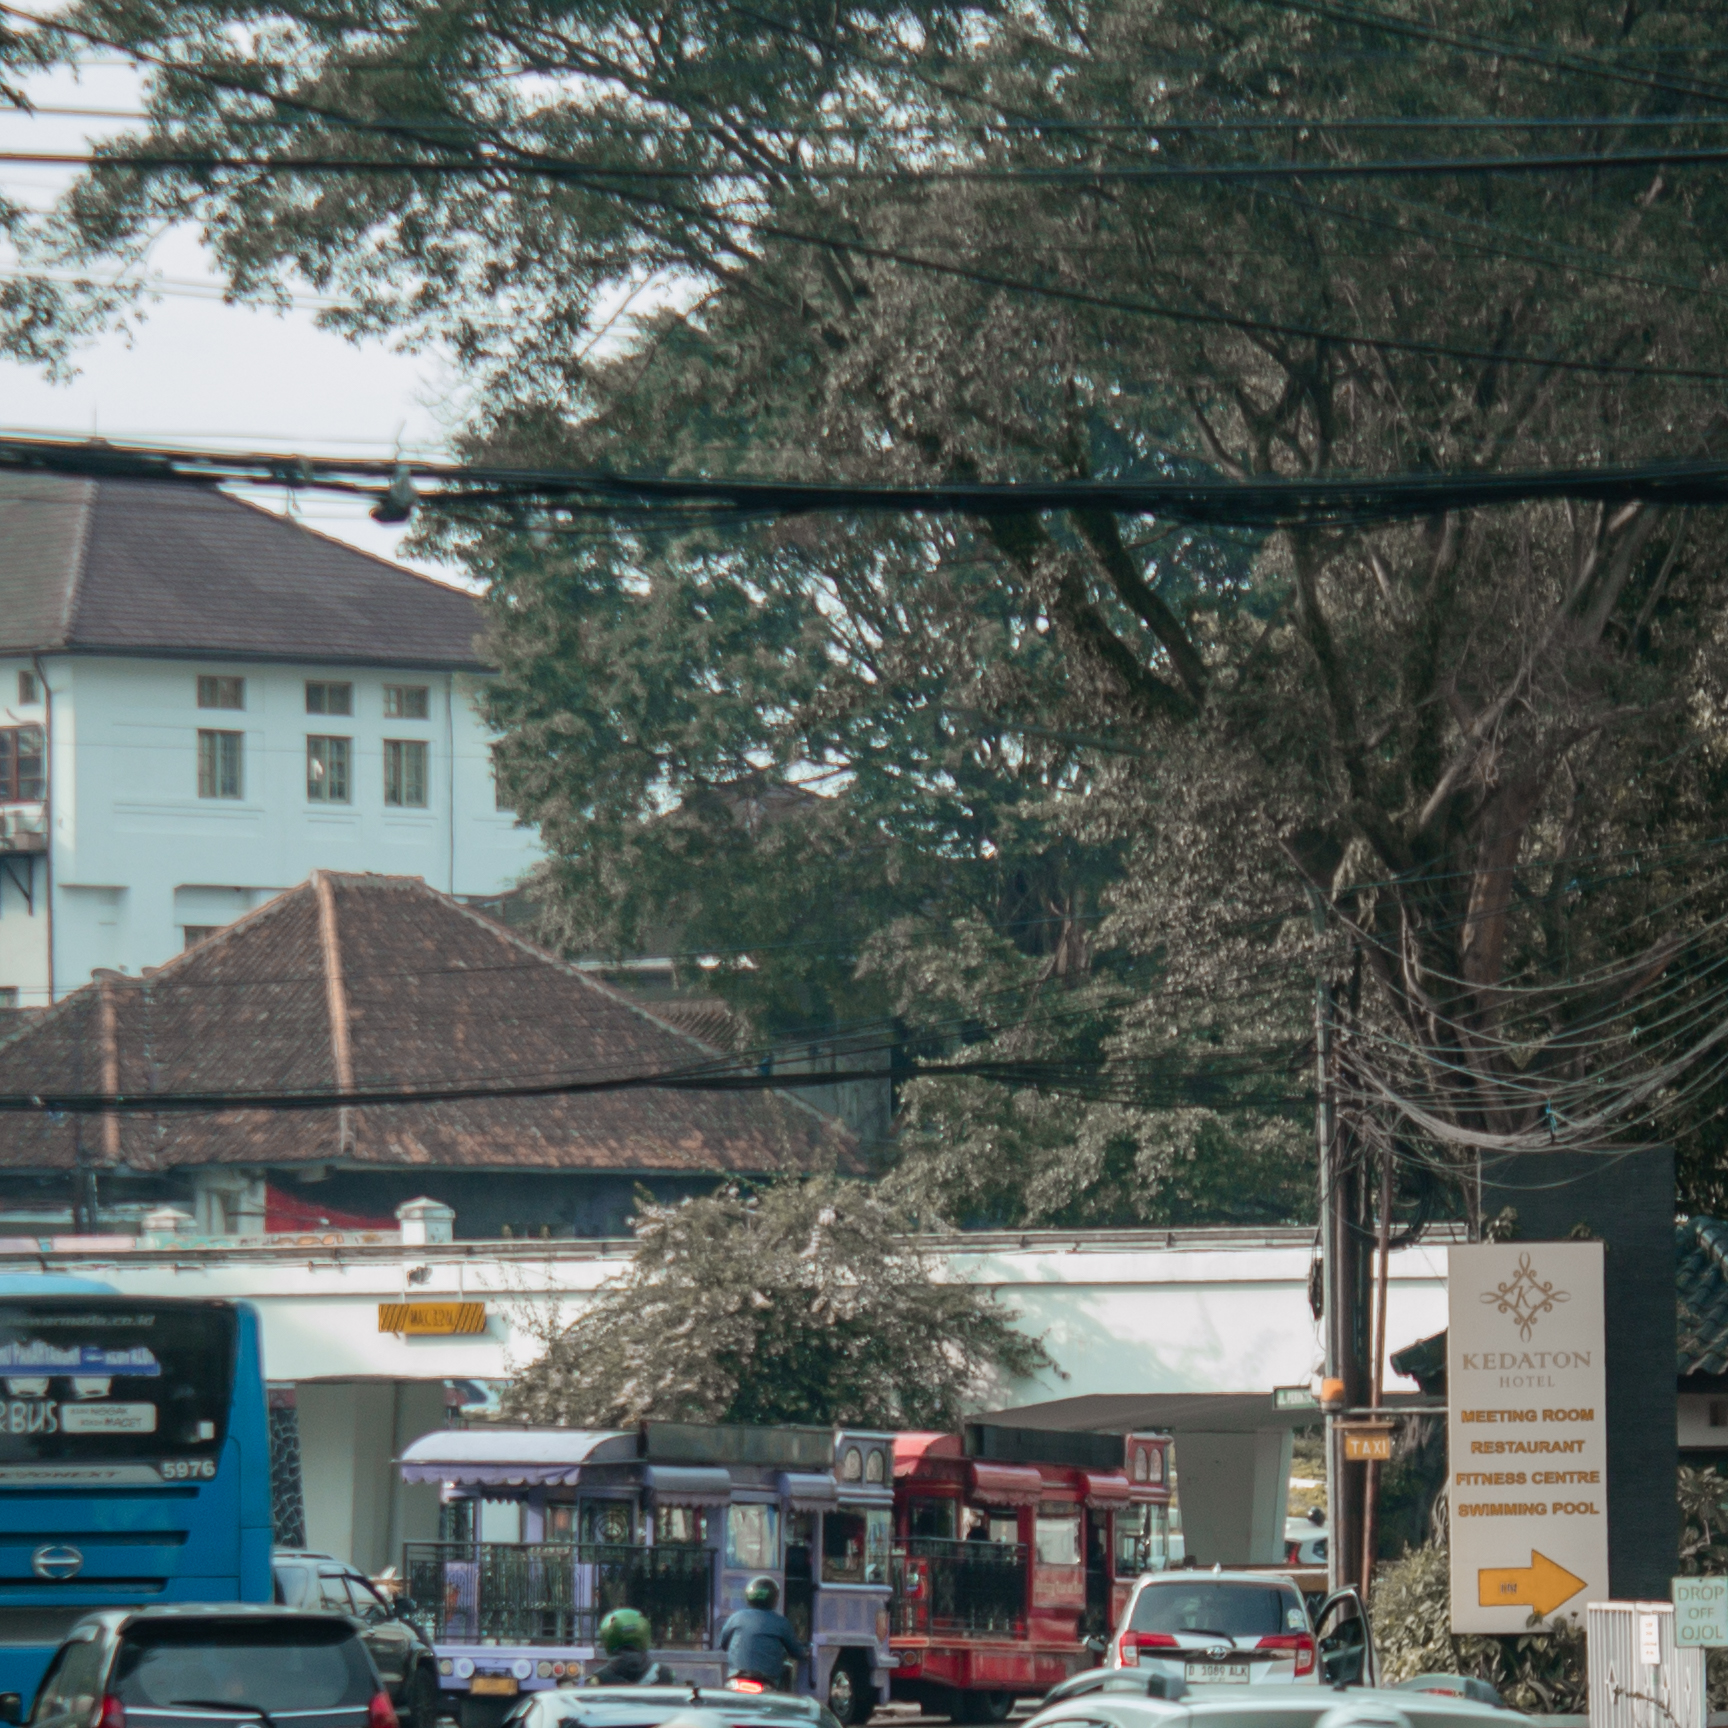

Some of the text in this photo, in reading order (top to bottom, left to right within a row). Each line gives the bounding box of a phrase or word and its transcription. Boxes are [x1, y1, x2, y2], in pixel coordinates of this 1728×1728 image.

[1462, 1351, 1591, 1370] KEDATON
[1499, 1375, 1556, 1388] HOTEL
[9, 1401, 58, 1434] BUS
[1461, 1408, 1594, 1423] MEETING ROOM
[1351, 1440, 1387, 1454] TAXI
[1471, 1440, 1585, 1454] RESTAURANT
[163, 1460, 216, 1479] 5976
[1456, 1471, 1601, 1486] FITNESS CENTRE
[1458, 1502, 1600, 1517] SWIMMING POOL
[1678, 1586, 1725, 1601] DROP
[1688, 1608, 1714, 1619] OFF
[1682, 1626, 1723, 1640] OJOL
